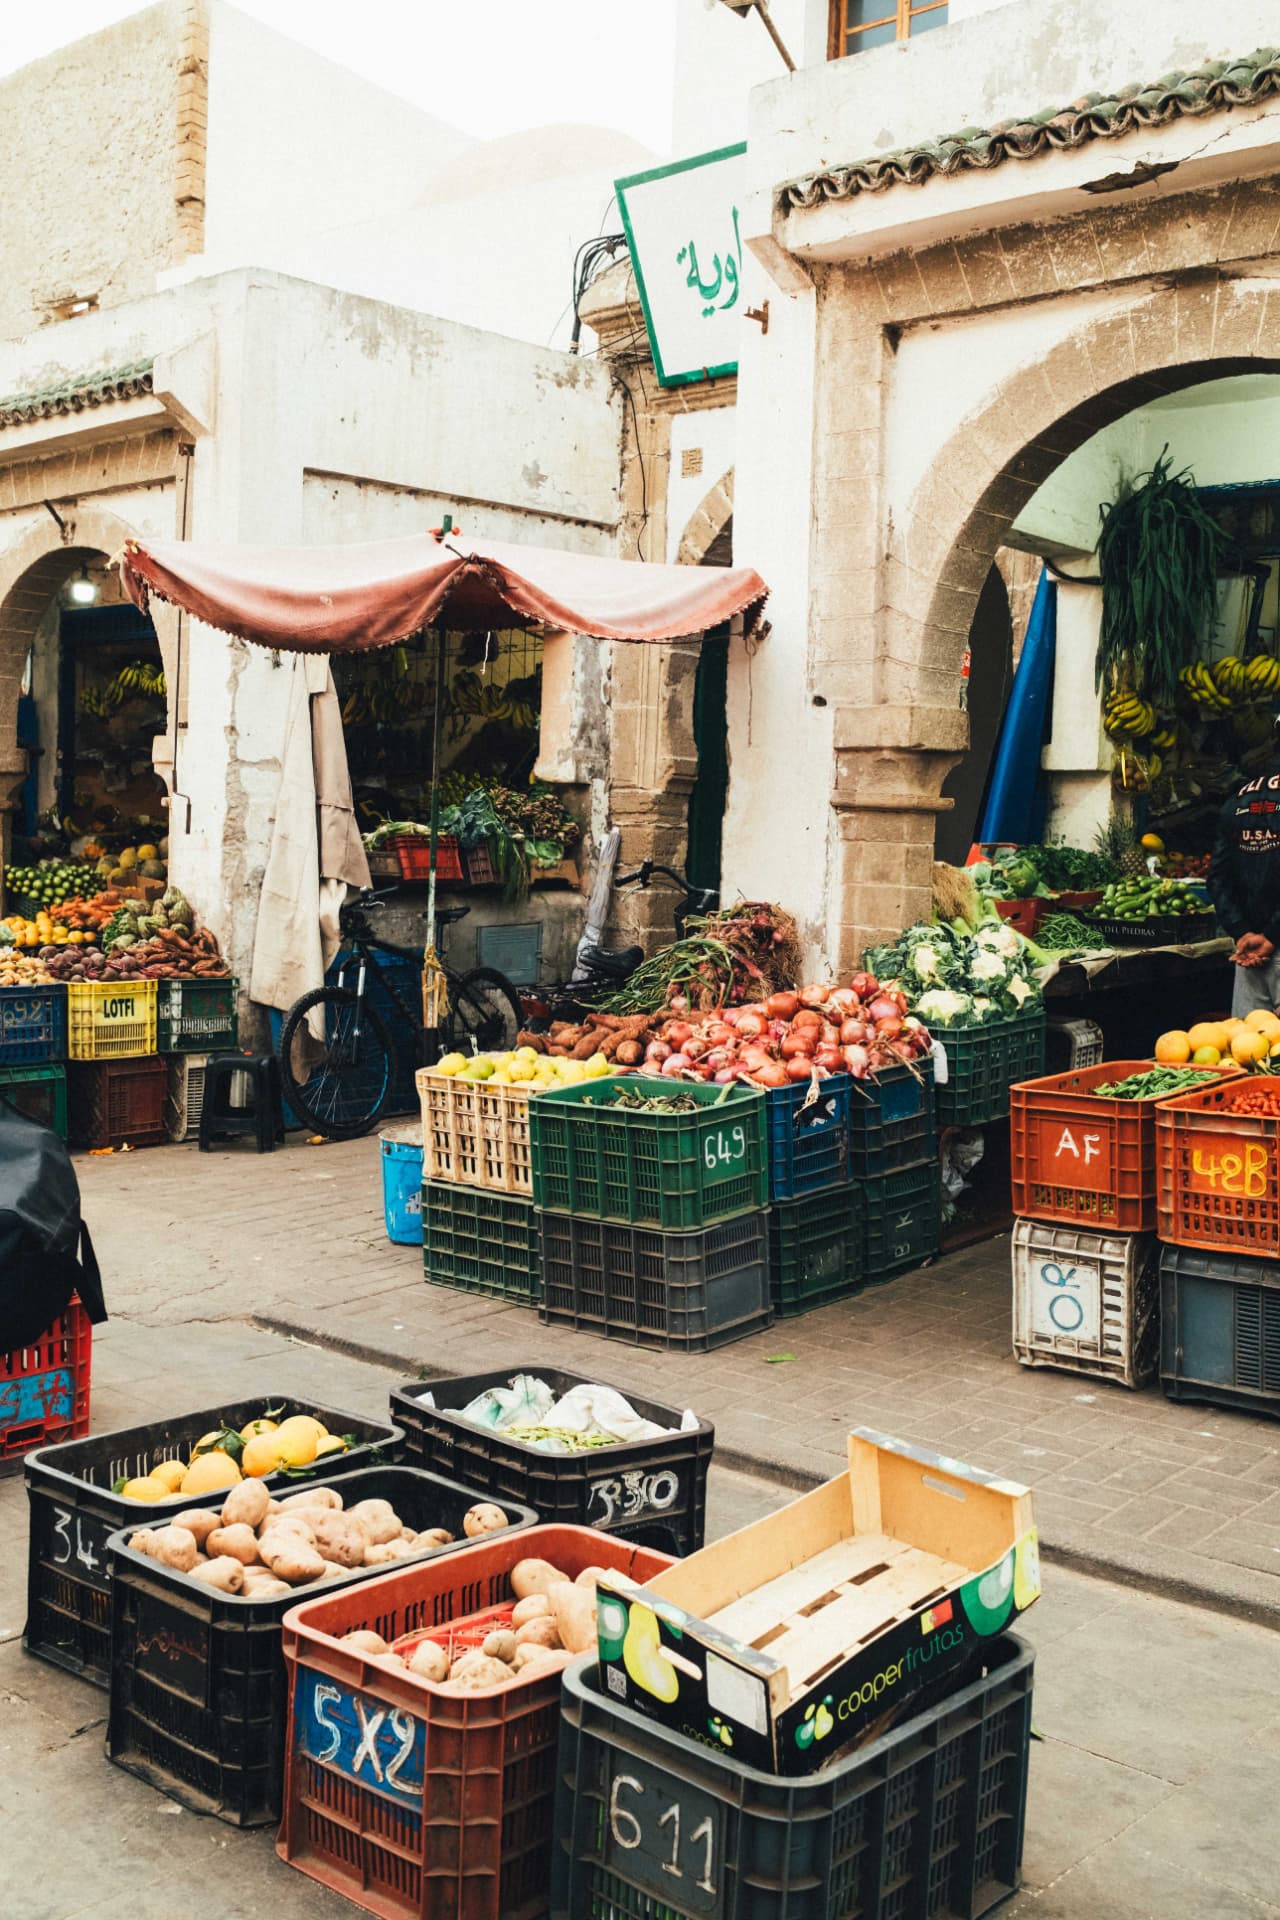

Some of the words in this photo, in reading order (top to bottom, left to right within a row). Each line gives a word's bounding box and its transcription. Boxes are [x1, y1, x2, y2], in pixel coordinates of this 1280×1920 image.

[1242, 829, 1277, 841] U.S.A.
[103, 998, 135, 1019] LOTFI
[704, 1126, 745, 1169] 649
[1055, 1127, 1100, 1164] AF
[53, 1508, 99, 1570] 34
[609, 1774, 717, 1895] 611
